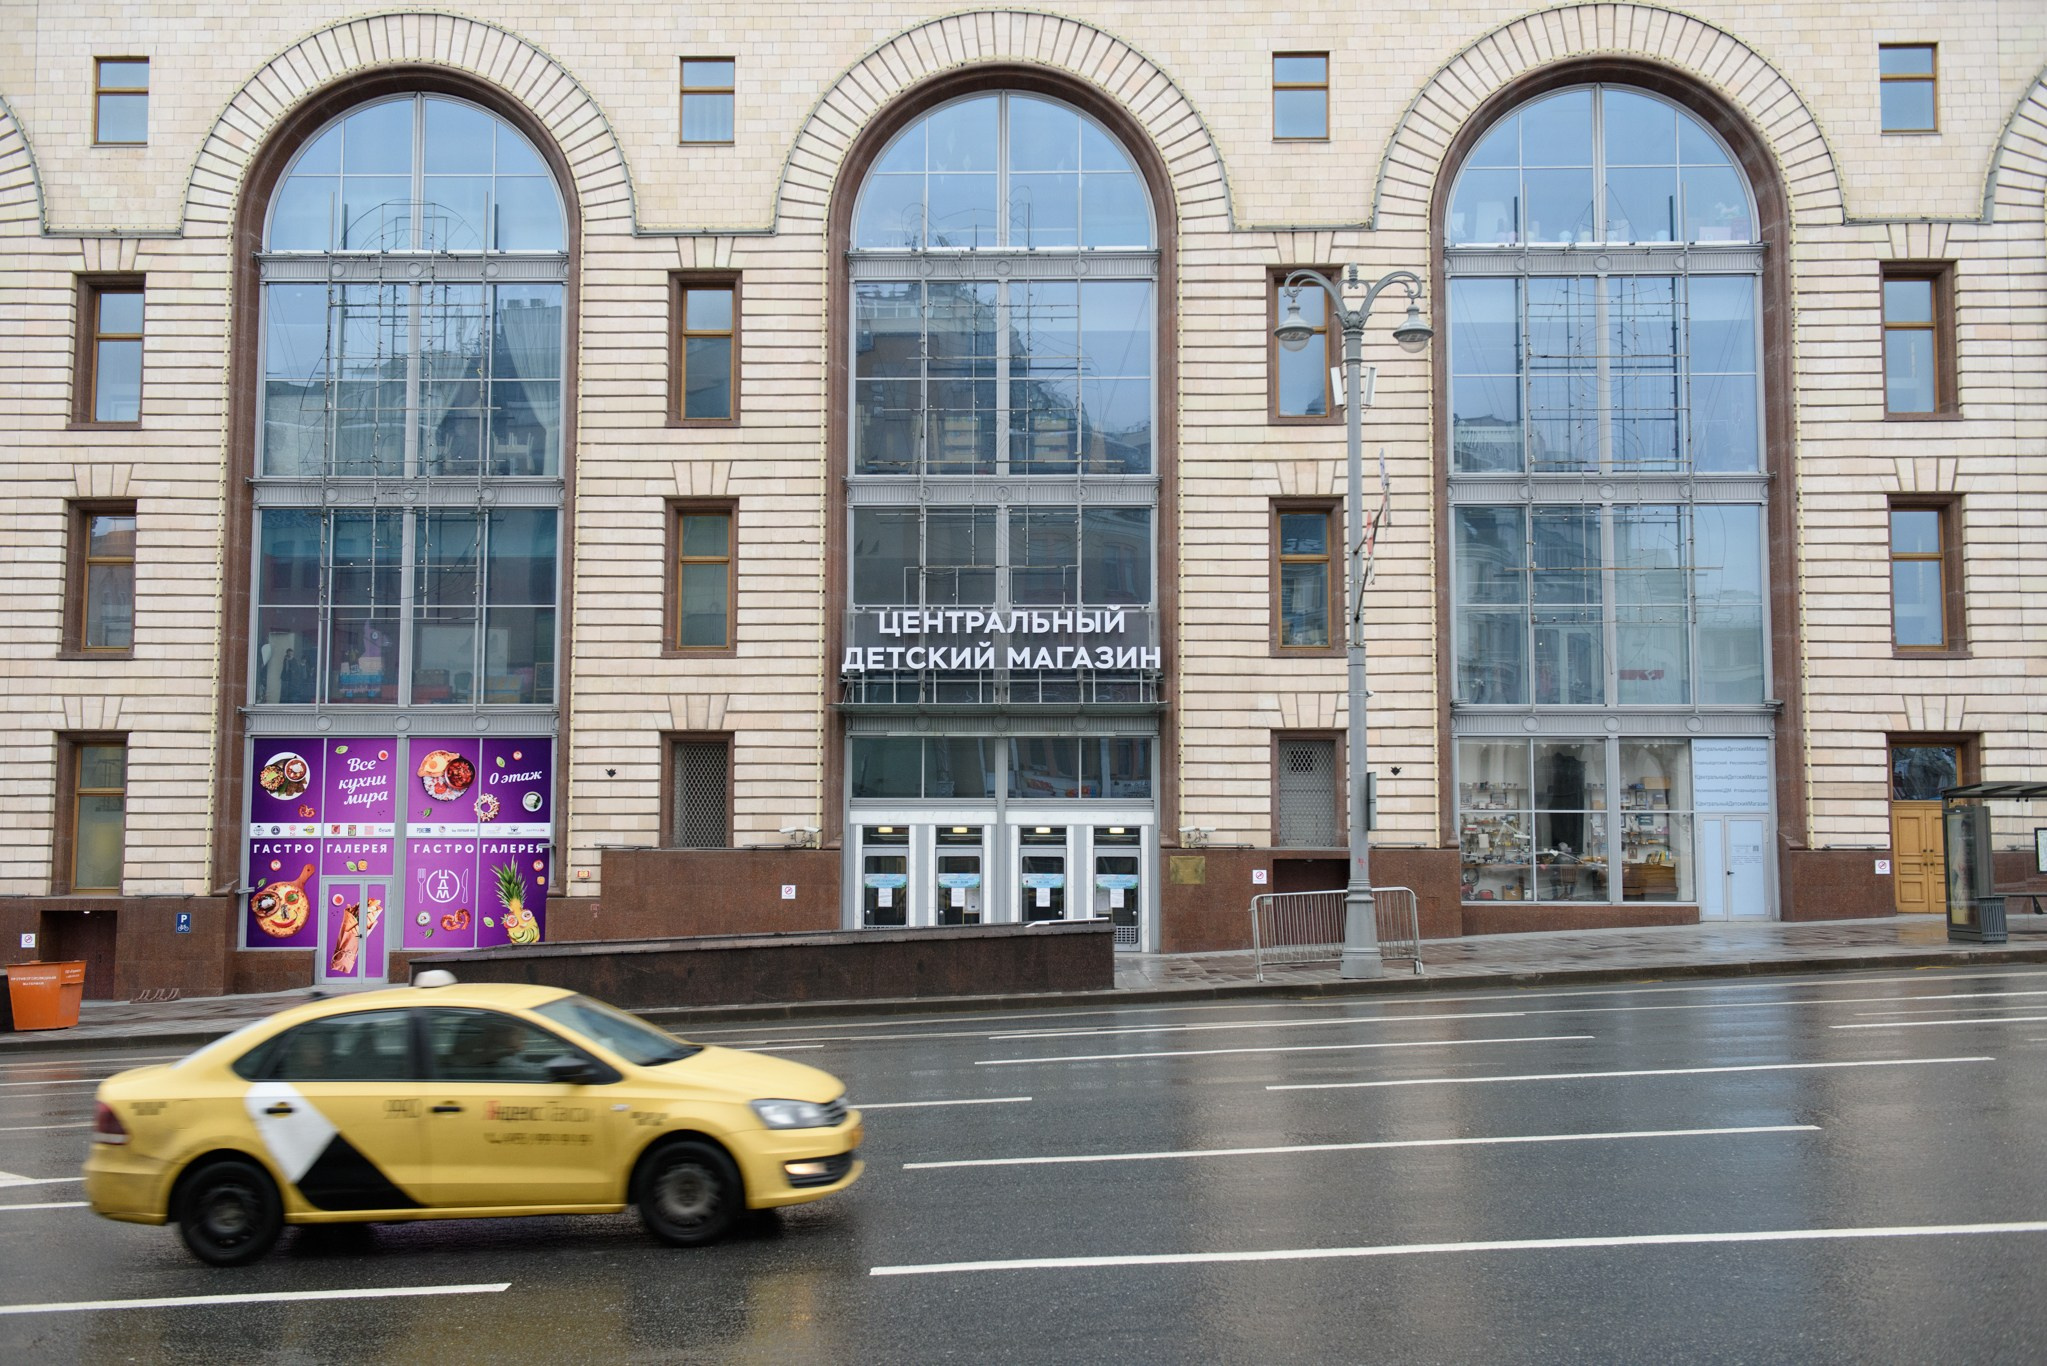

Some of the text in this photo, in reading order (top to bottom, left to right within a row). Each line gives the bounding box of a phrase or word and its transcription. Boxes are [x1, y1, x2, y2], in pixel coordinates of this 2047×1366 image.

[879, 605, 1125, 637] ЦЕНТРАЛЬНЫЙ
[842, 642, 1162, 673] ДЕТСКИЙ МАГАЗИН
[347, 757, 377, 772] Все
[501, 770, 543, 783] этаж
[338, 775, 387, 794] кухни
[343, 790, 389, 808] мира
[253, 844, 388, 854] ГАСТРО ГАЛЕРЕЯ
[413, 844, 544, 854] ГАСТРО ГАЛЕРЕЯ
[180, 914, 188, 923] P
